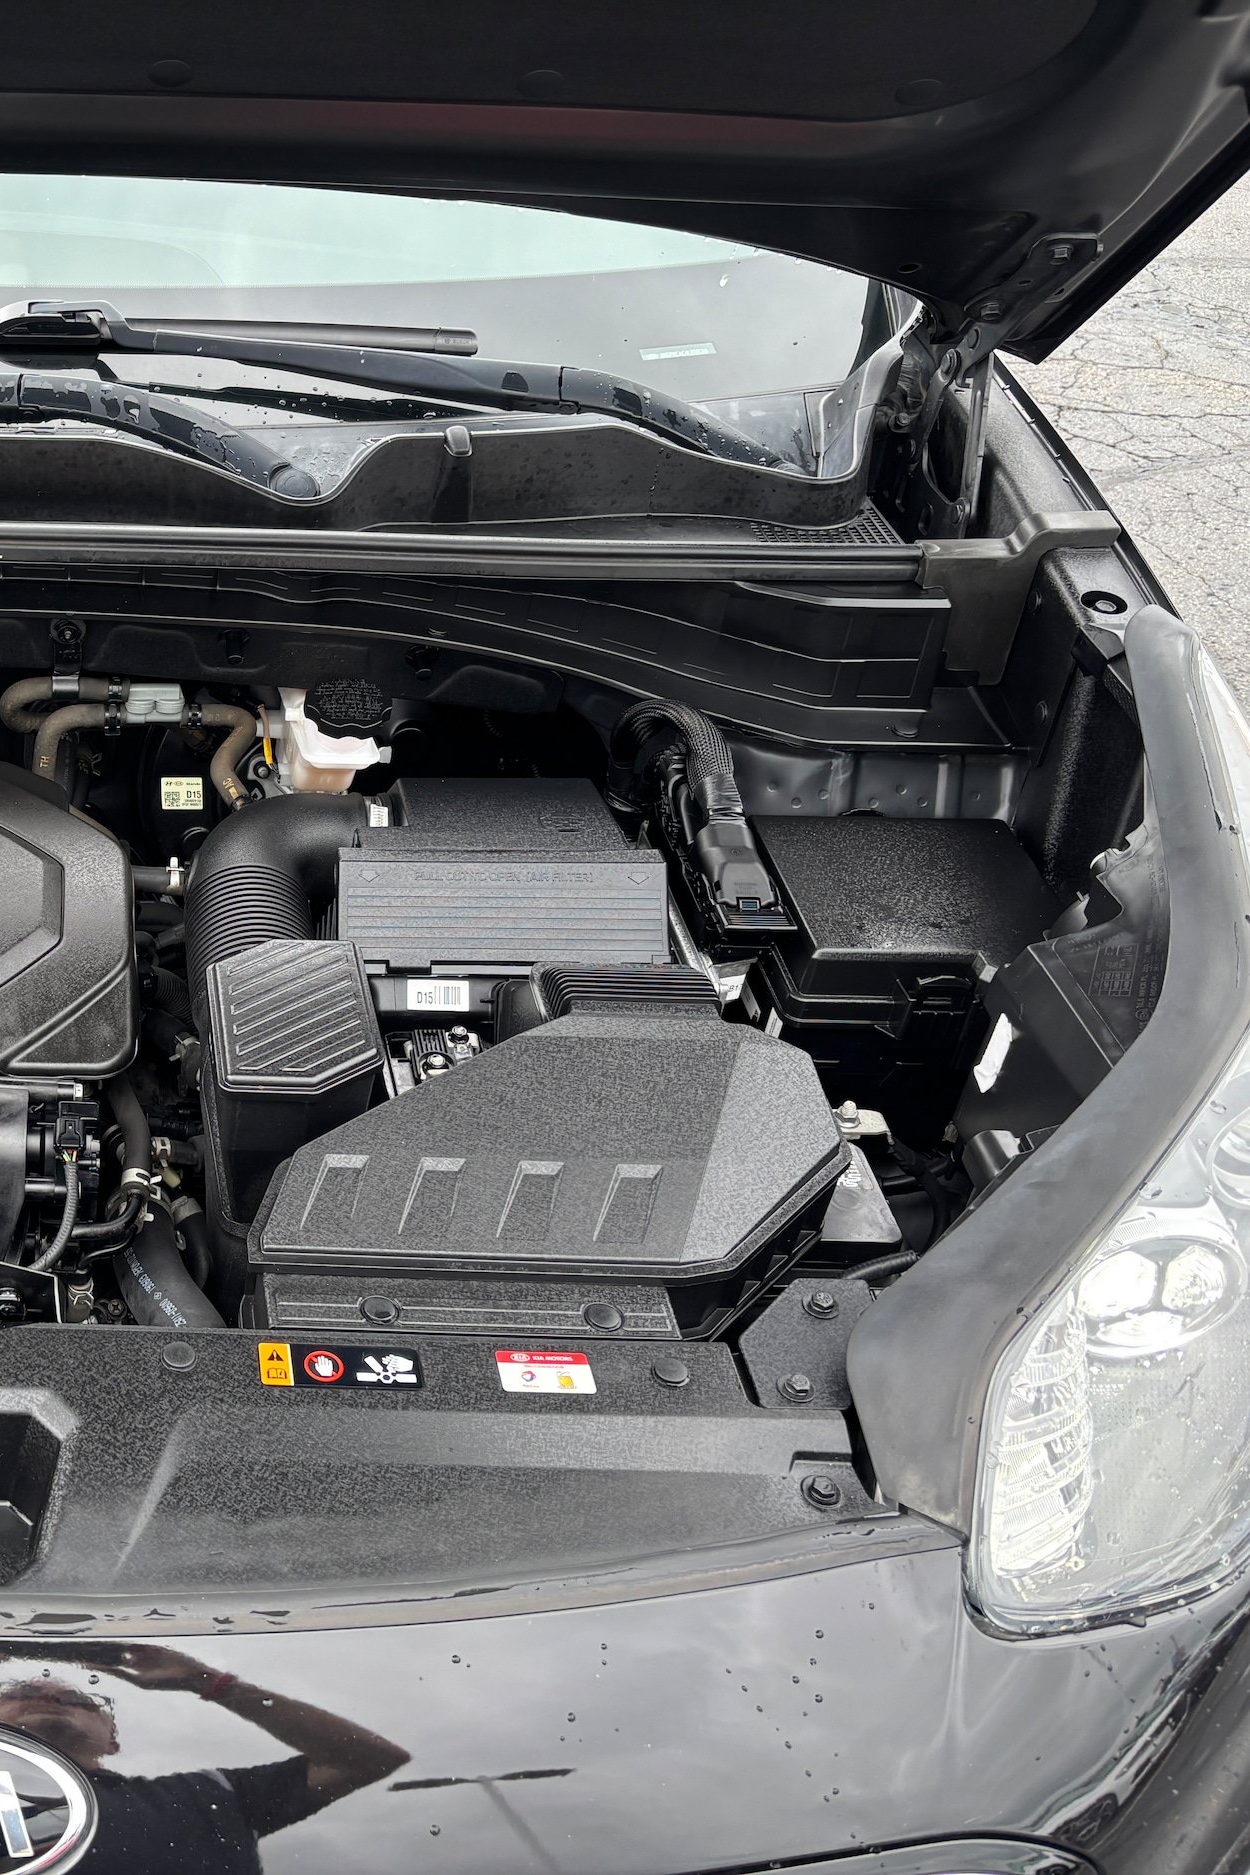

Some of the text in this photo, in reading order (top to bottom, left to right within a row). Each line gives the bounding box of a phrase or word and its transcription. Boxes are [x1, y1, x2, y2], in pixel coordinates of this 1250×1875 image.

[39, 755, 50, 768] TH
[186, 790, 202, 799] D15
[416, 991, 434, 1005] D15
